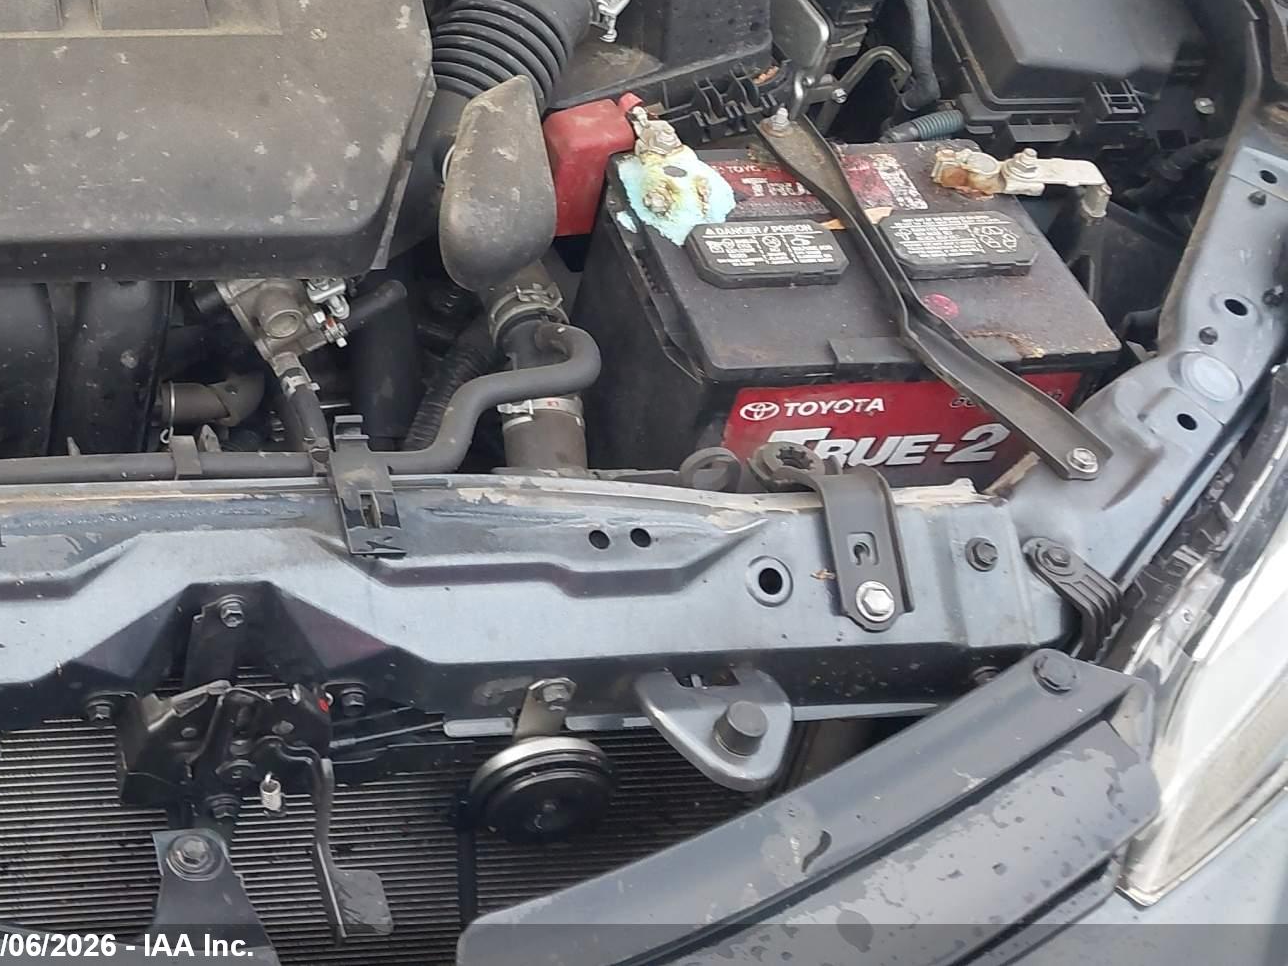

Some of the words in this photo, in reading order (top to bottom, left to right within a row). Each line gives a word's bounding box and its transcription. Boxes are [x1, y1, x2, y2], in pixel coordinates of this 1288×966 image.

[740, 177, 813, 197] TRU
[784, 397, 886, 418] TOYOTA
[767, 423, 1011, 468] TRUE-2
